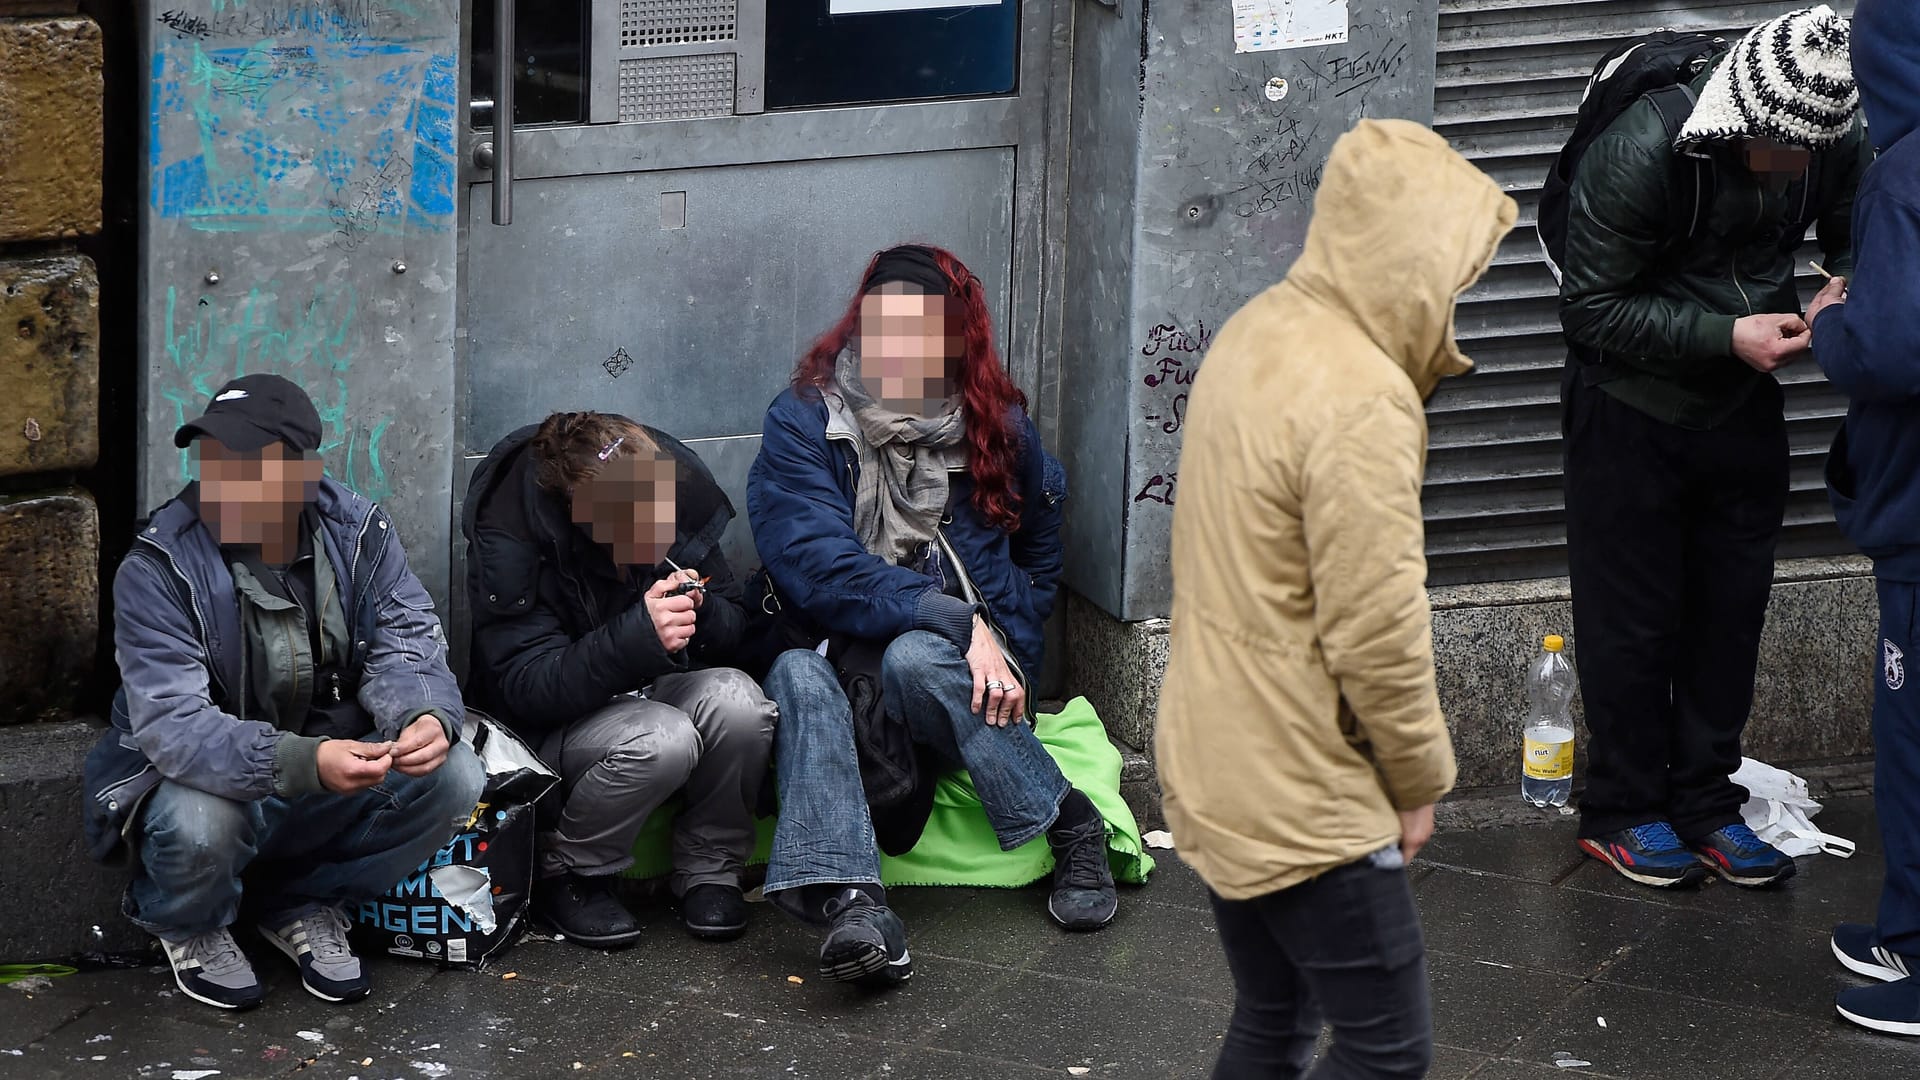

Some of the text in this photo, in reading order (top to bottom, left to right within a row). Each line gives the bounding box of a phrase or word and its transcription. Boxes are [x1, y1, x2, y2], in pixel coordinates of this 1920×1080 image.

[1324, 32, 1344, 41] HKT
[1142, 318, 1212, 356] Fuck
[1134, 472, 1178, 506] Li
